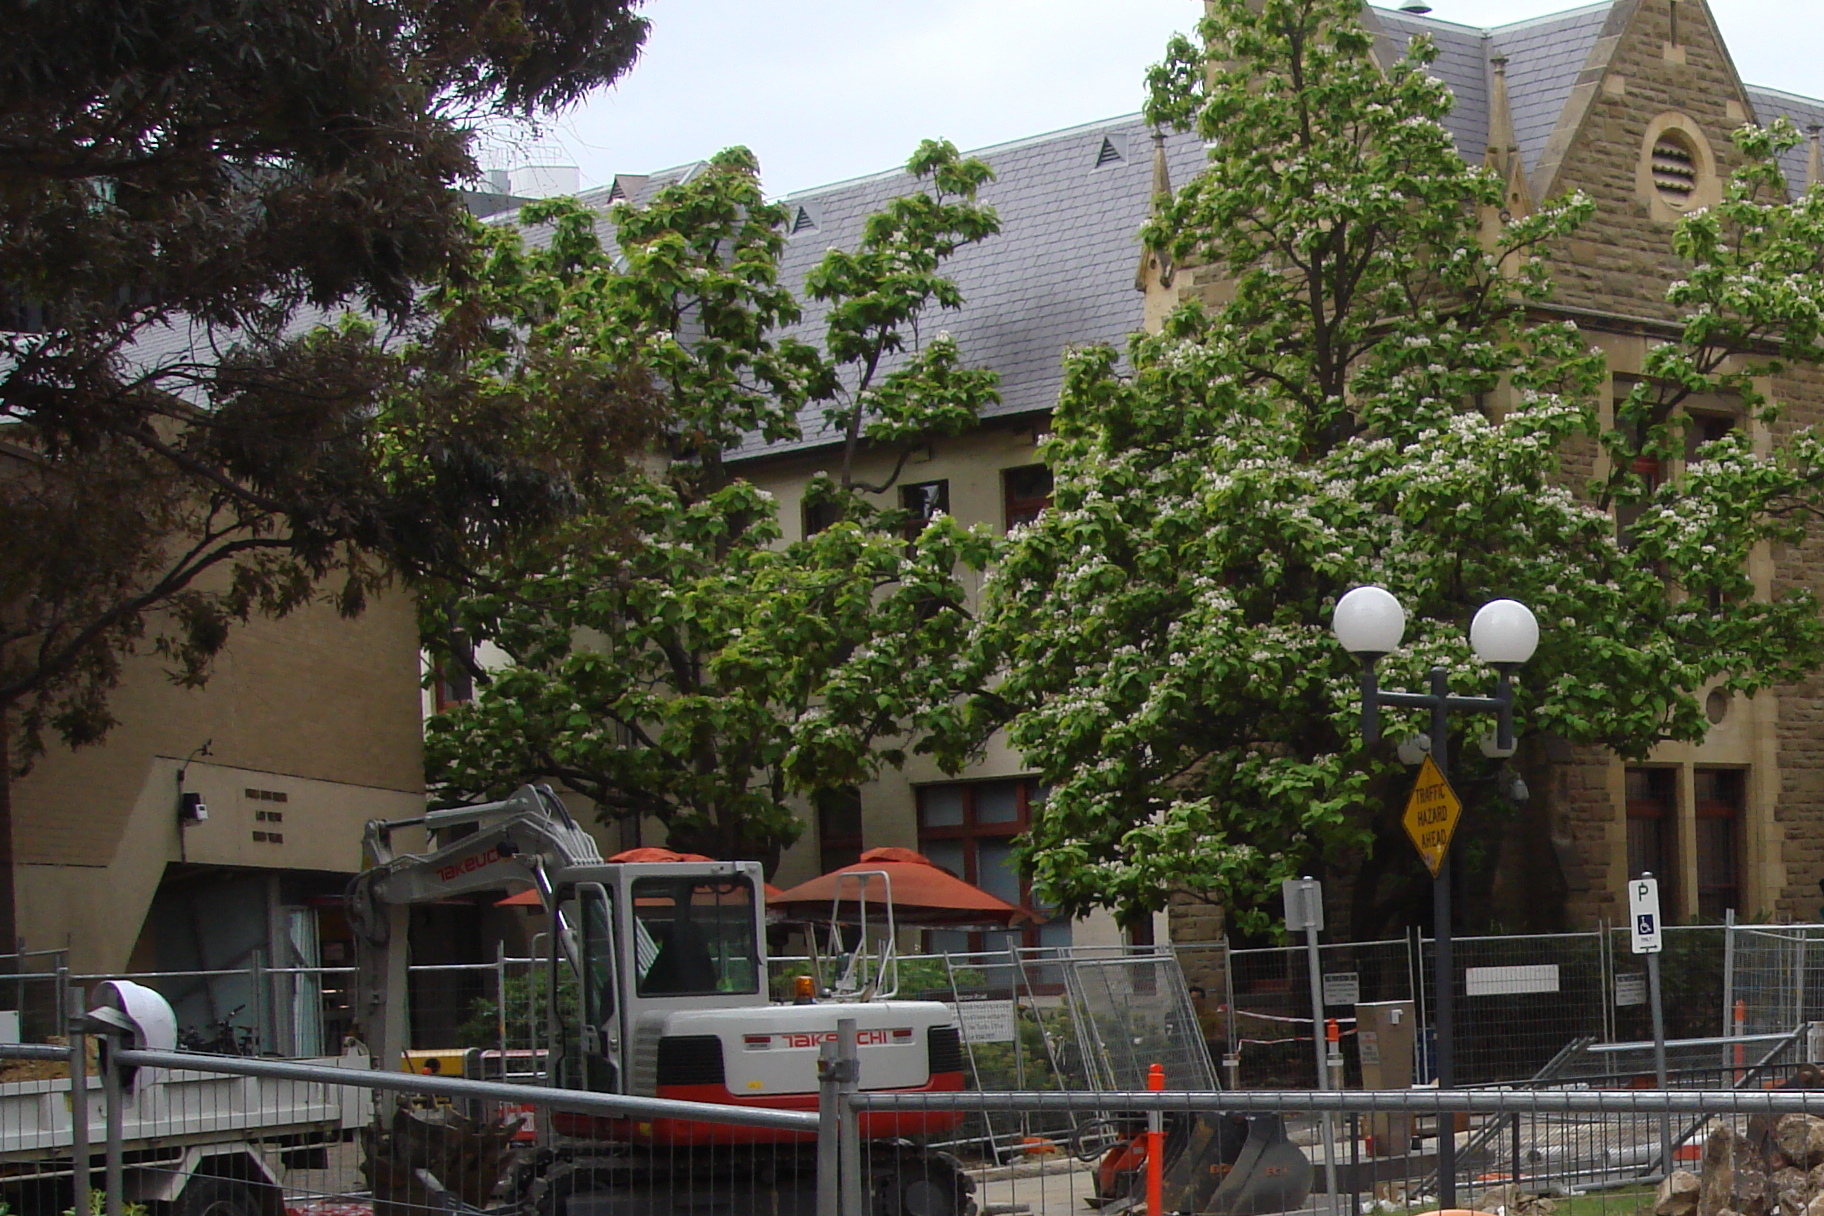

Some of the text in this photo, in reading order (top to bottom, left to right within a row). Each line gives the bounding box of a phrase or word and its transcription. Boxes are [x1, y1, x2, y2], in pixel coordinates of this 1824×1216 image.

[1415, 783, 1446, 805] TRAFFIC
[1417, 805, 1448, 827] HAZARD
[1421, 828, 1447, 849] AHEAD
[1638, 885, 1649, 902] P
